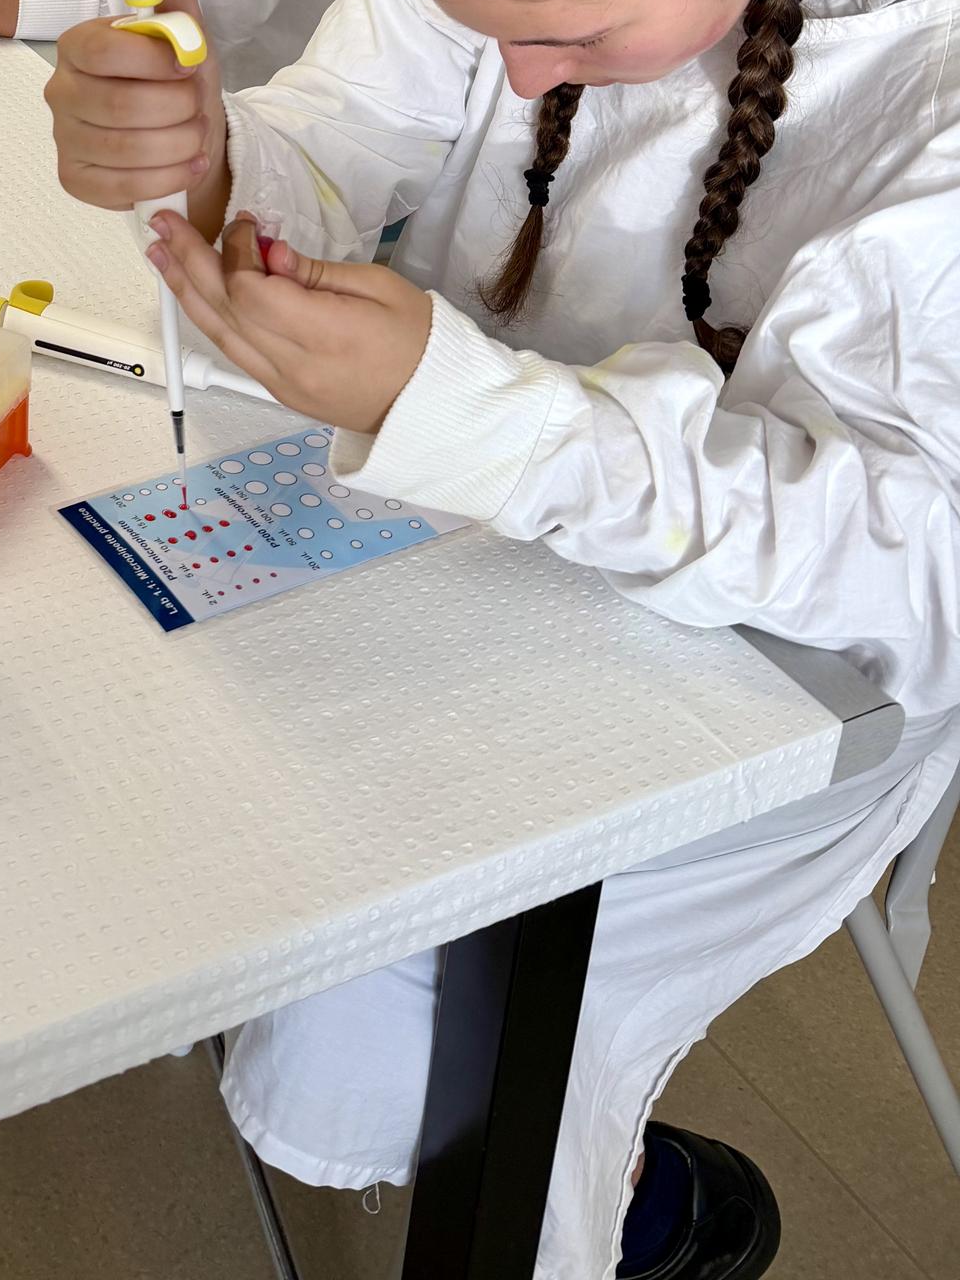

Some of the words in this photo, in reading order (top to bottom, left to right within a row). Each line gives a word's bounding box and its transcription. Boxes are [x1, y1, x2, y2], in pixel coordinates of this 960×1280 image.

[214, 487, 260, 528] micropipette
[78, 507, 109, 533] practice
[118, 520, 163, 565] micropipette
[258, 528, 280, 548] P200
[285, 537, 297, 546] 50
[105, 534, 150, 580] Micropipette
[160, 543, 172, 553] 10
[160, 564, 177, 582] P20
[308, 560, 321, 570] 20
[146, 580, 162, 596] 1.1:
[160, 597, 178, 615] Lab
